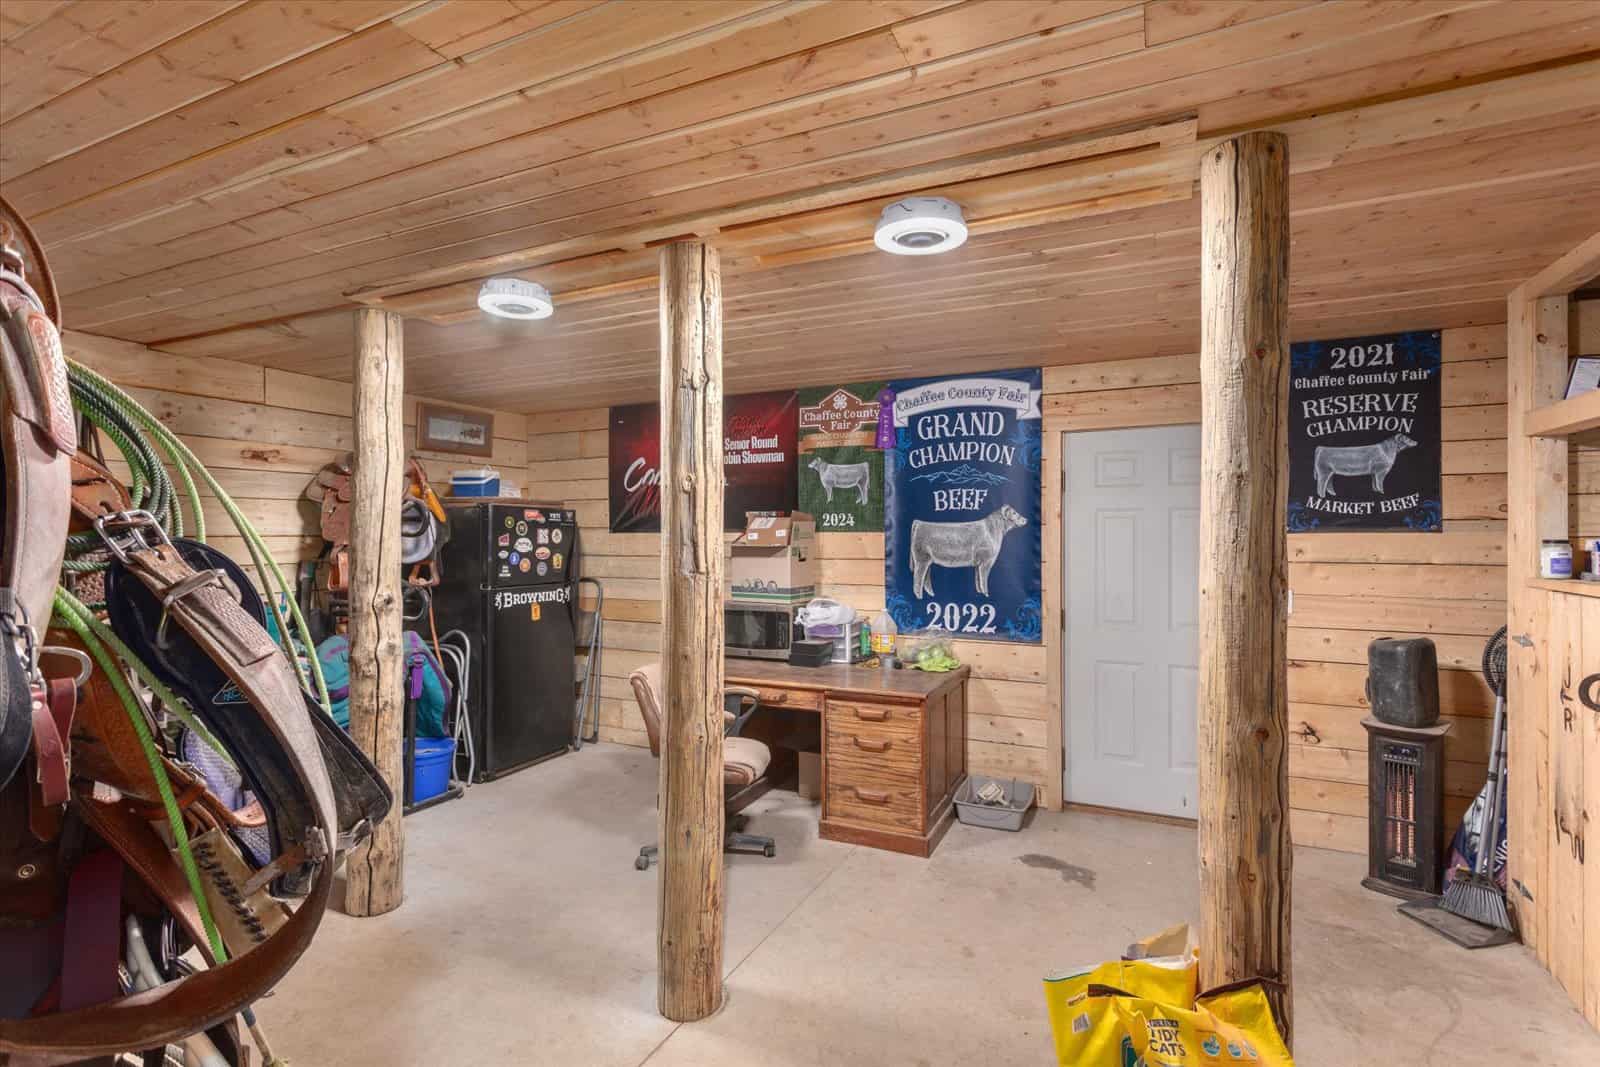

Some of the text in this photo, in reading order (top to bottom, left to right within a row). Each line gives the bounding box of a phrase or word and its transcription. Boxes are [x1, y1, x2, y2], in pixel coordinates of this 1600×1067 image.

[1330, 343, 1395, 370] 2021
[1294, 368, 1431, 390] Chaffee County Fair
[897, 384, 1028, 413] Chaffee County Fair
[1302, 392, 1419, 419] RESERVE
[804, 408, 880, 422] Chaffee County
[831, 420, 852, 431] Fair
[917, 411, 1005, 440] GRAND
[1306, 415, 1414, 438] CHAMPION
[724, 434, 779, 451] Senior Round
[723, 451, 785, 464] obin Showman
[908, 441, 1016, 469] CHAMPION
[933, 488, 989, 512] BEEF
[1305, 492, 1420, 515] MARKET BEEF
[822, 512, 856, 527] 2024
[503, 587, 566, 608] BROWNING
[926, 602, 997, 634] 2022
[1151, 1029, 1181, 1042] TIDY
[1149, 1039, 1186, 1057] CATS
